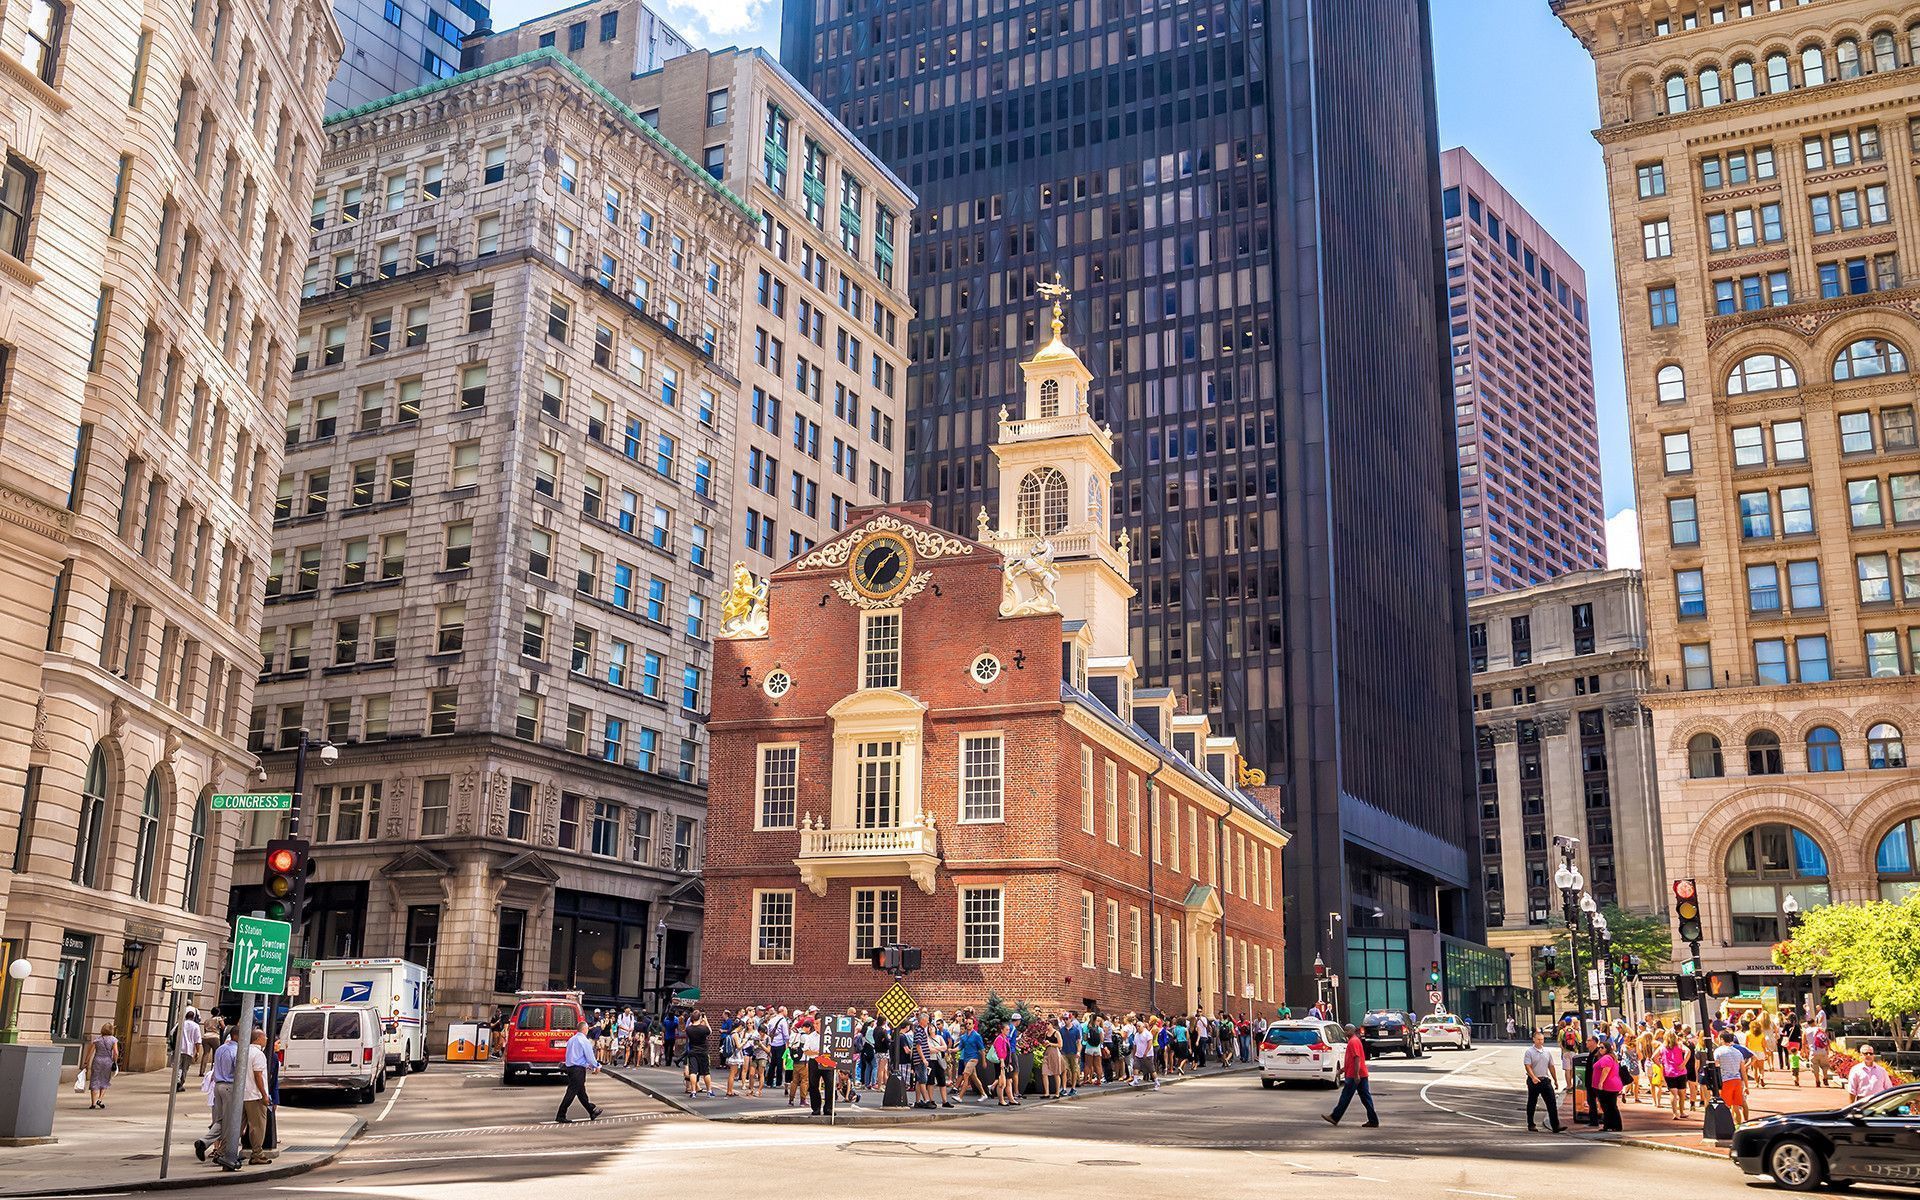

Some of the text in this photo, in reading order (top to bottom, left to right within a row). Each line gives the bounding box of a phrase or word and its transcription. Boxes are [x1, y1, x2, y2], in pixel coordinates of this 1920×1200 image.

[226, 796, 278, 808] CONGRESS
[244, 924, 262, 935] Station
[262, 938, 285, 949] Downtown
[186, 946, 197, 956] NO
[260, 949, 282, 962] Crossing
[182, 960, 199, 970] TURN
[260, 964, 283, 974] Government
[175, 974, 201, 985] ON RED
[259, 975, 274, 984] Center
[823, 1016, 832, 1053] PARK
[835, 1037, 852, 1048] 7.00
